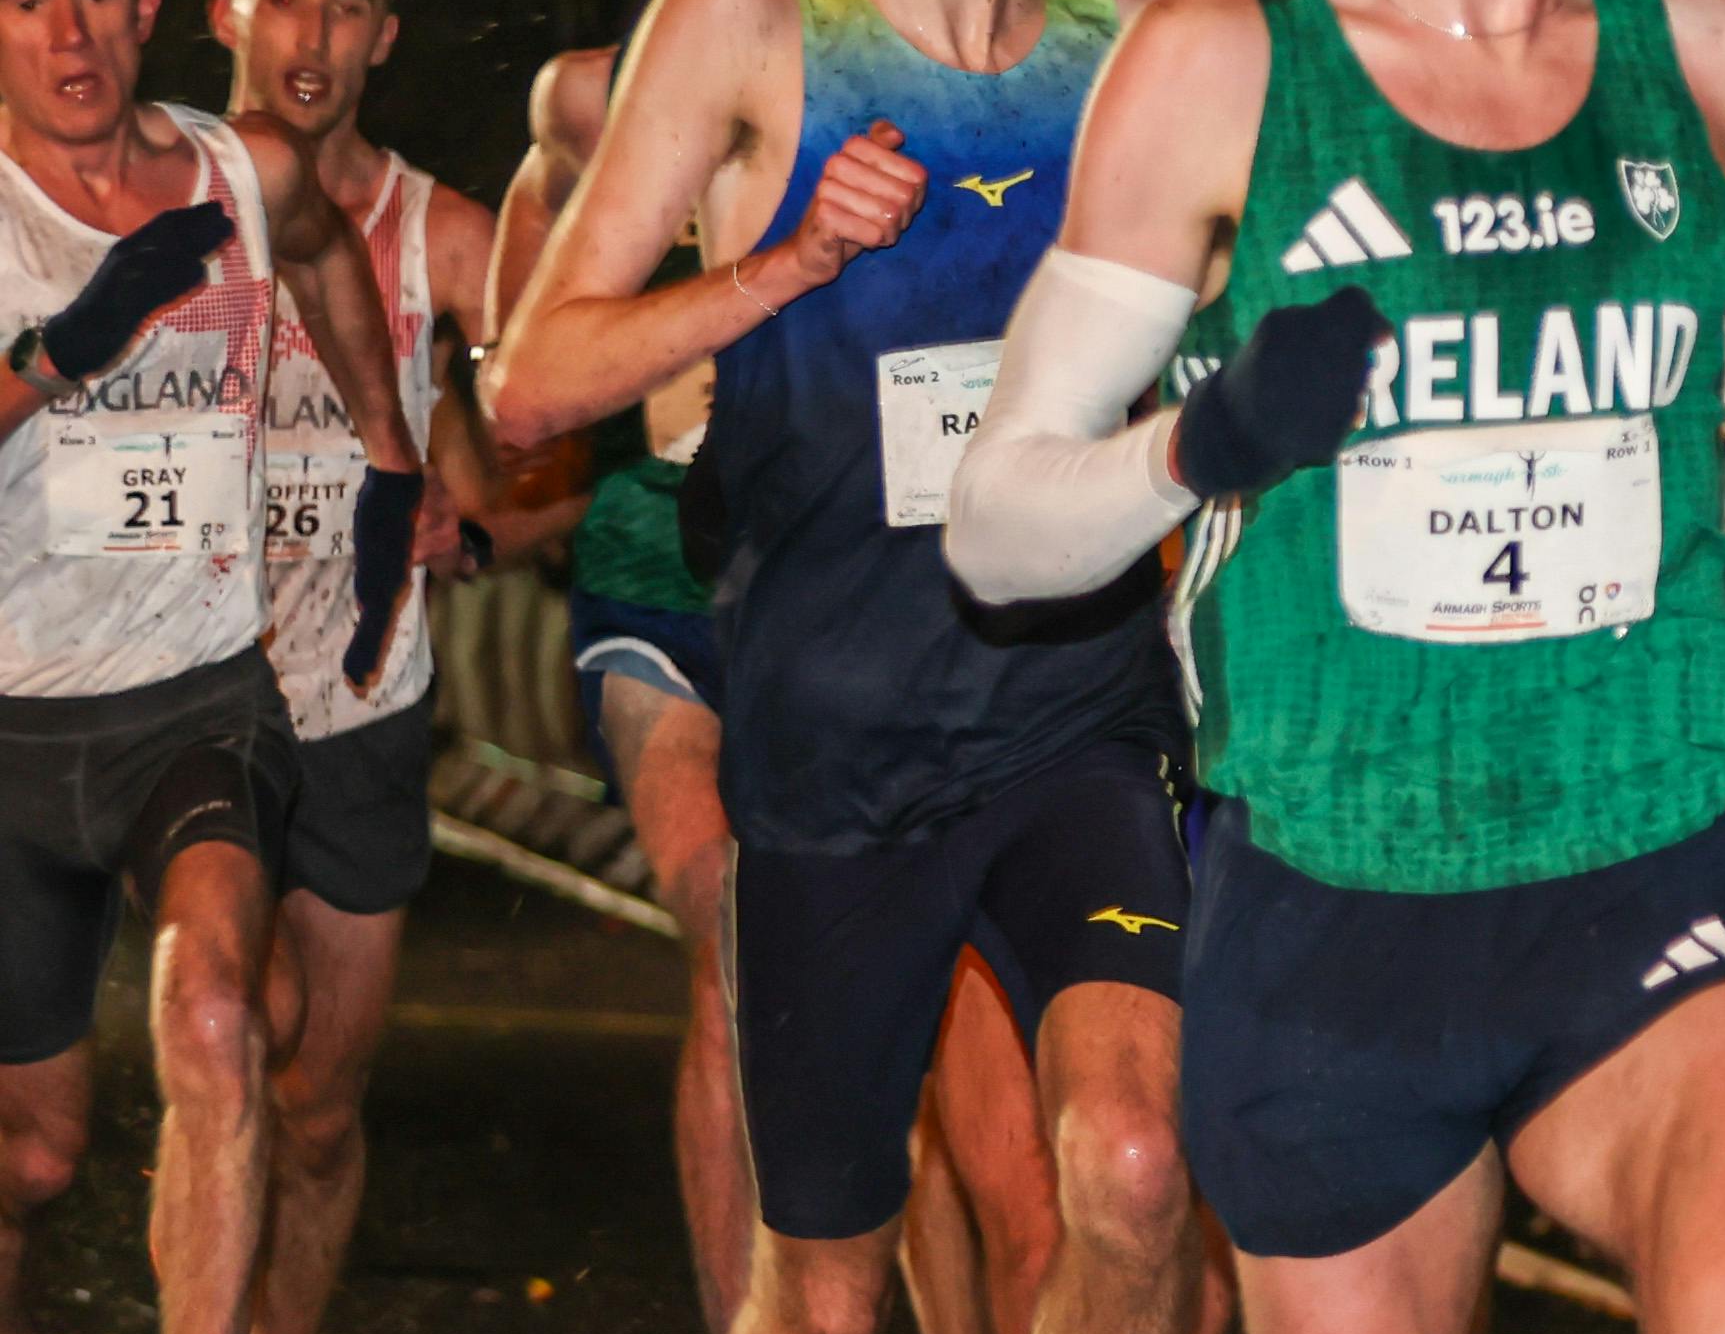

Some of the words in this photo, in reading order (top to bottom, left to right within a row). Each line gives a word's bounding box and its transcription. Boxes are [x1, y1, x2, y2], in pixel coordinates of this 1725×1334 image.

[1433, 193, 1596, 256] 123.ie
[892, 372, 926, 386] Row
[931, 371, 941, 383] 2
[1358, 303, 1698, 430] RELAND
[941, 411, 980, 436] RA
[1357, 454, 1397, 468] Row
[1404, 456, 1413, 469] 1
[1606, 445, 1639, 460] Row
[1642, 443, 1651, 454] 1
[122, 466, 188, 487] GRAY
[266, 481, 347, 500] OFFITT
[123, 490, 186, 529] 21
[265, 503, 321, 537] 26
[1429, 501, 1585, 535] DALTON
[1482, 539, 1530, 596] 4
[1432, 601, 1488, 615] ARMAGH
[1491, 599, 1542, 614] SPORTS
